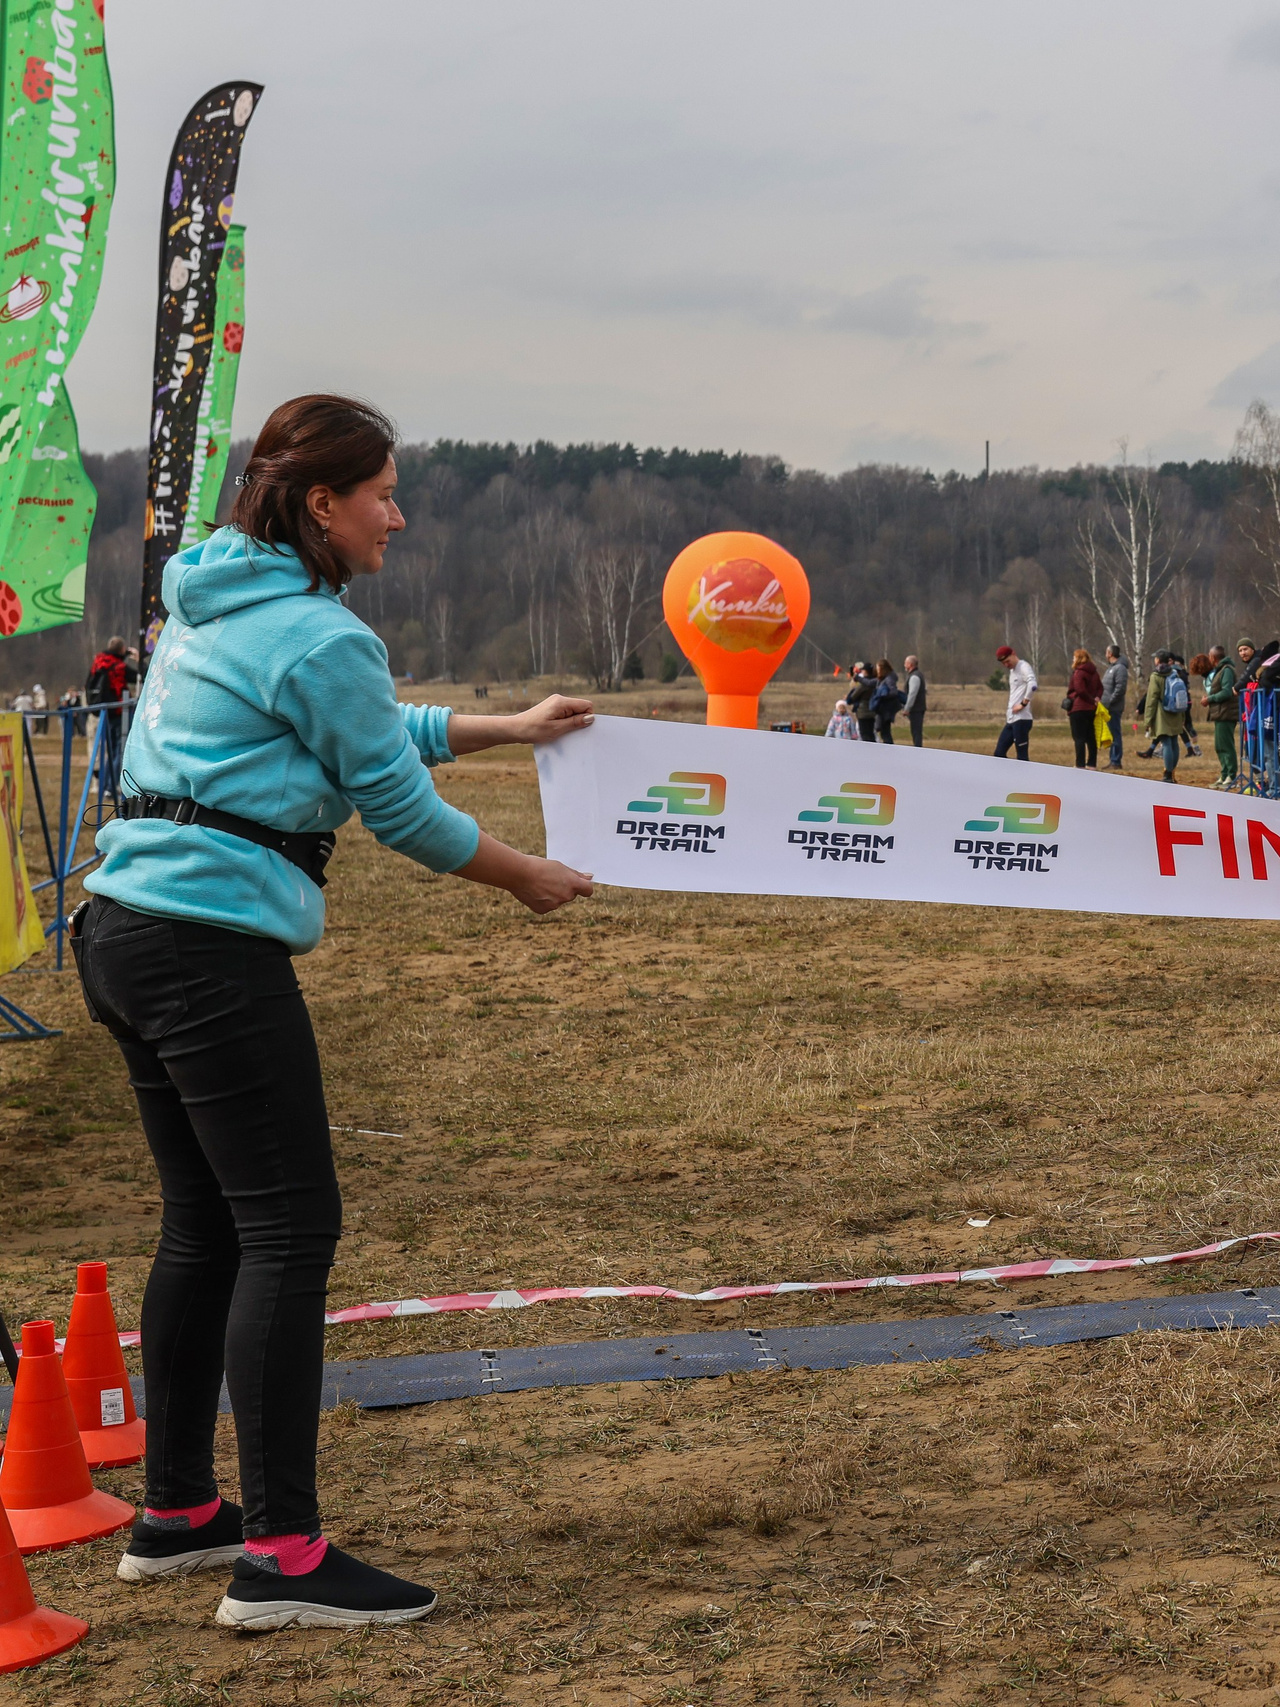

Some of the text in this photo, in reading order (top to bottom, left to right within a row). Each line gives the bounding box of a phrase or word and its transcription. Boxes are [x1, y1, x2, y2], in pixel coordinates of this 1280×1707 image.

[687, 576, 789, 623] Химки
[617, 821, 725, 839] DREAM
[630, 837, 717, 853] TRAIL
[787, 830, 895, 849] DREAM
[801, 846, 886, 863] TRAIL
[953, 840, 1059, 857] DREAM
[967, 856, 1050, 872] TRAIL
